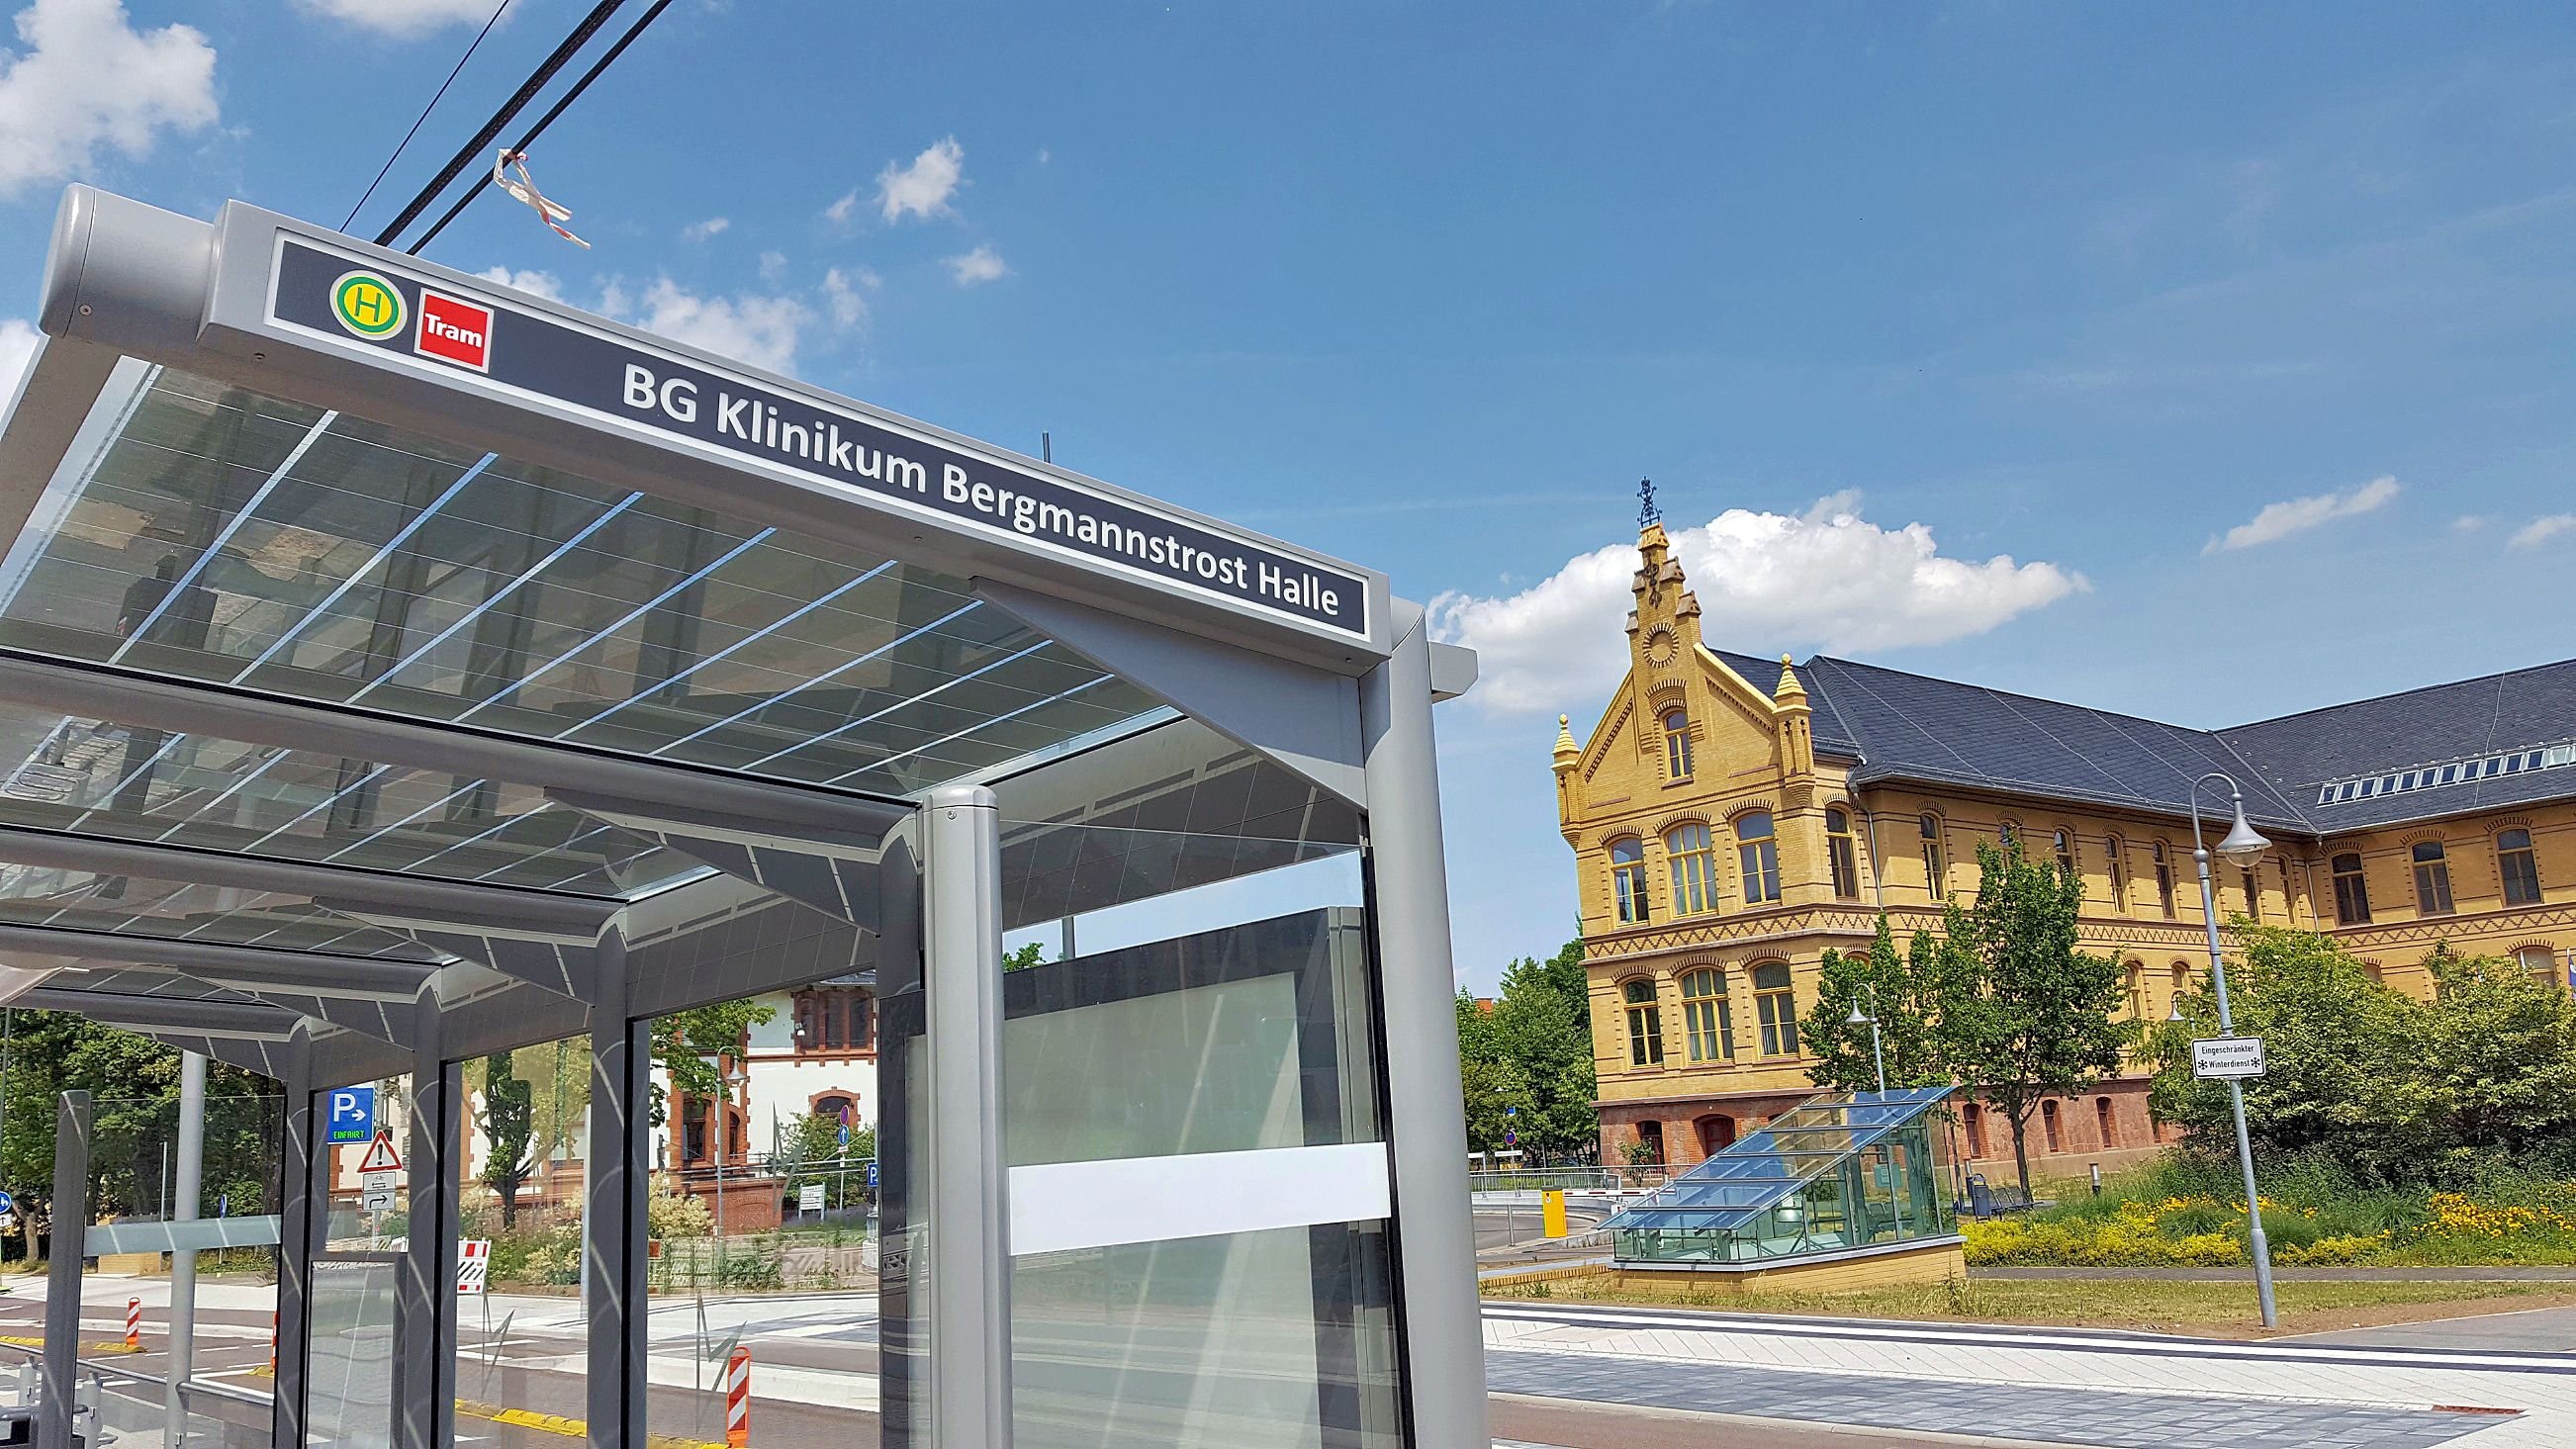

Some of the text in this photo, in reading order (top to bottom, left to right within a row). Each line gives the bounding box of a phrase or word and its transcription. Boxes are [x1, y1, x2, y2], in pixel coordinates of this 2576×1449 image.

[354, 287, 383, 323] H
[425, 313, 483, 348] Tram
[623, 363, 1339, 616] BG Klinikum Bergmannstrost Halle
[2201, 1043, 2254, 1056] Eingeschränkter
[2208, 1059, 2251, 1069] Winterdienst
[333, 1093, 356, 1123] P
[333, 1130, 365, 1140] EINFAHRT
